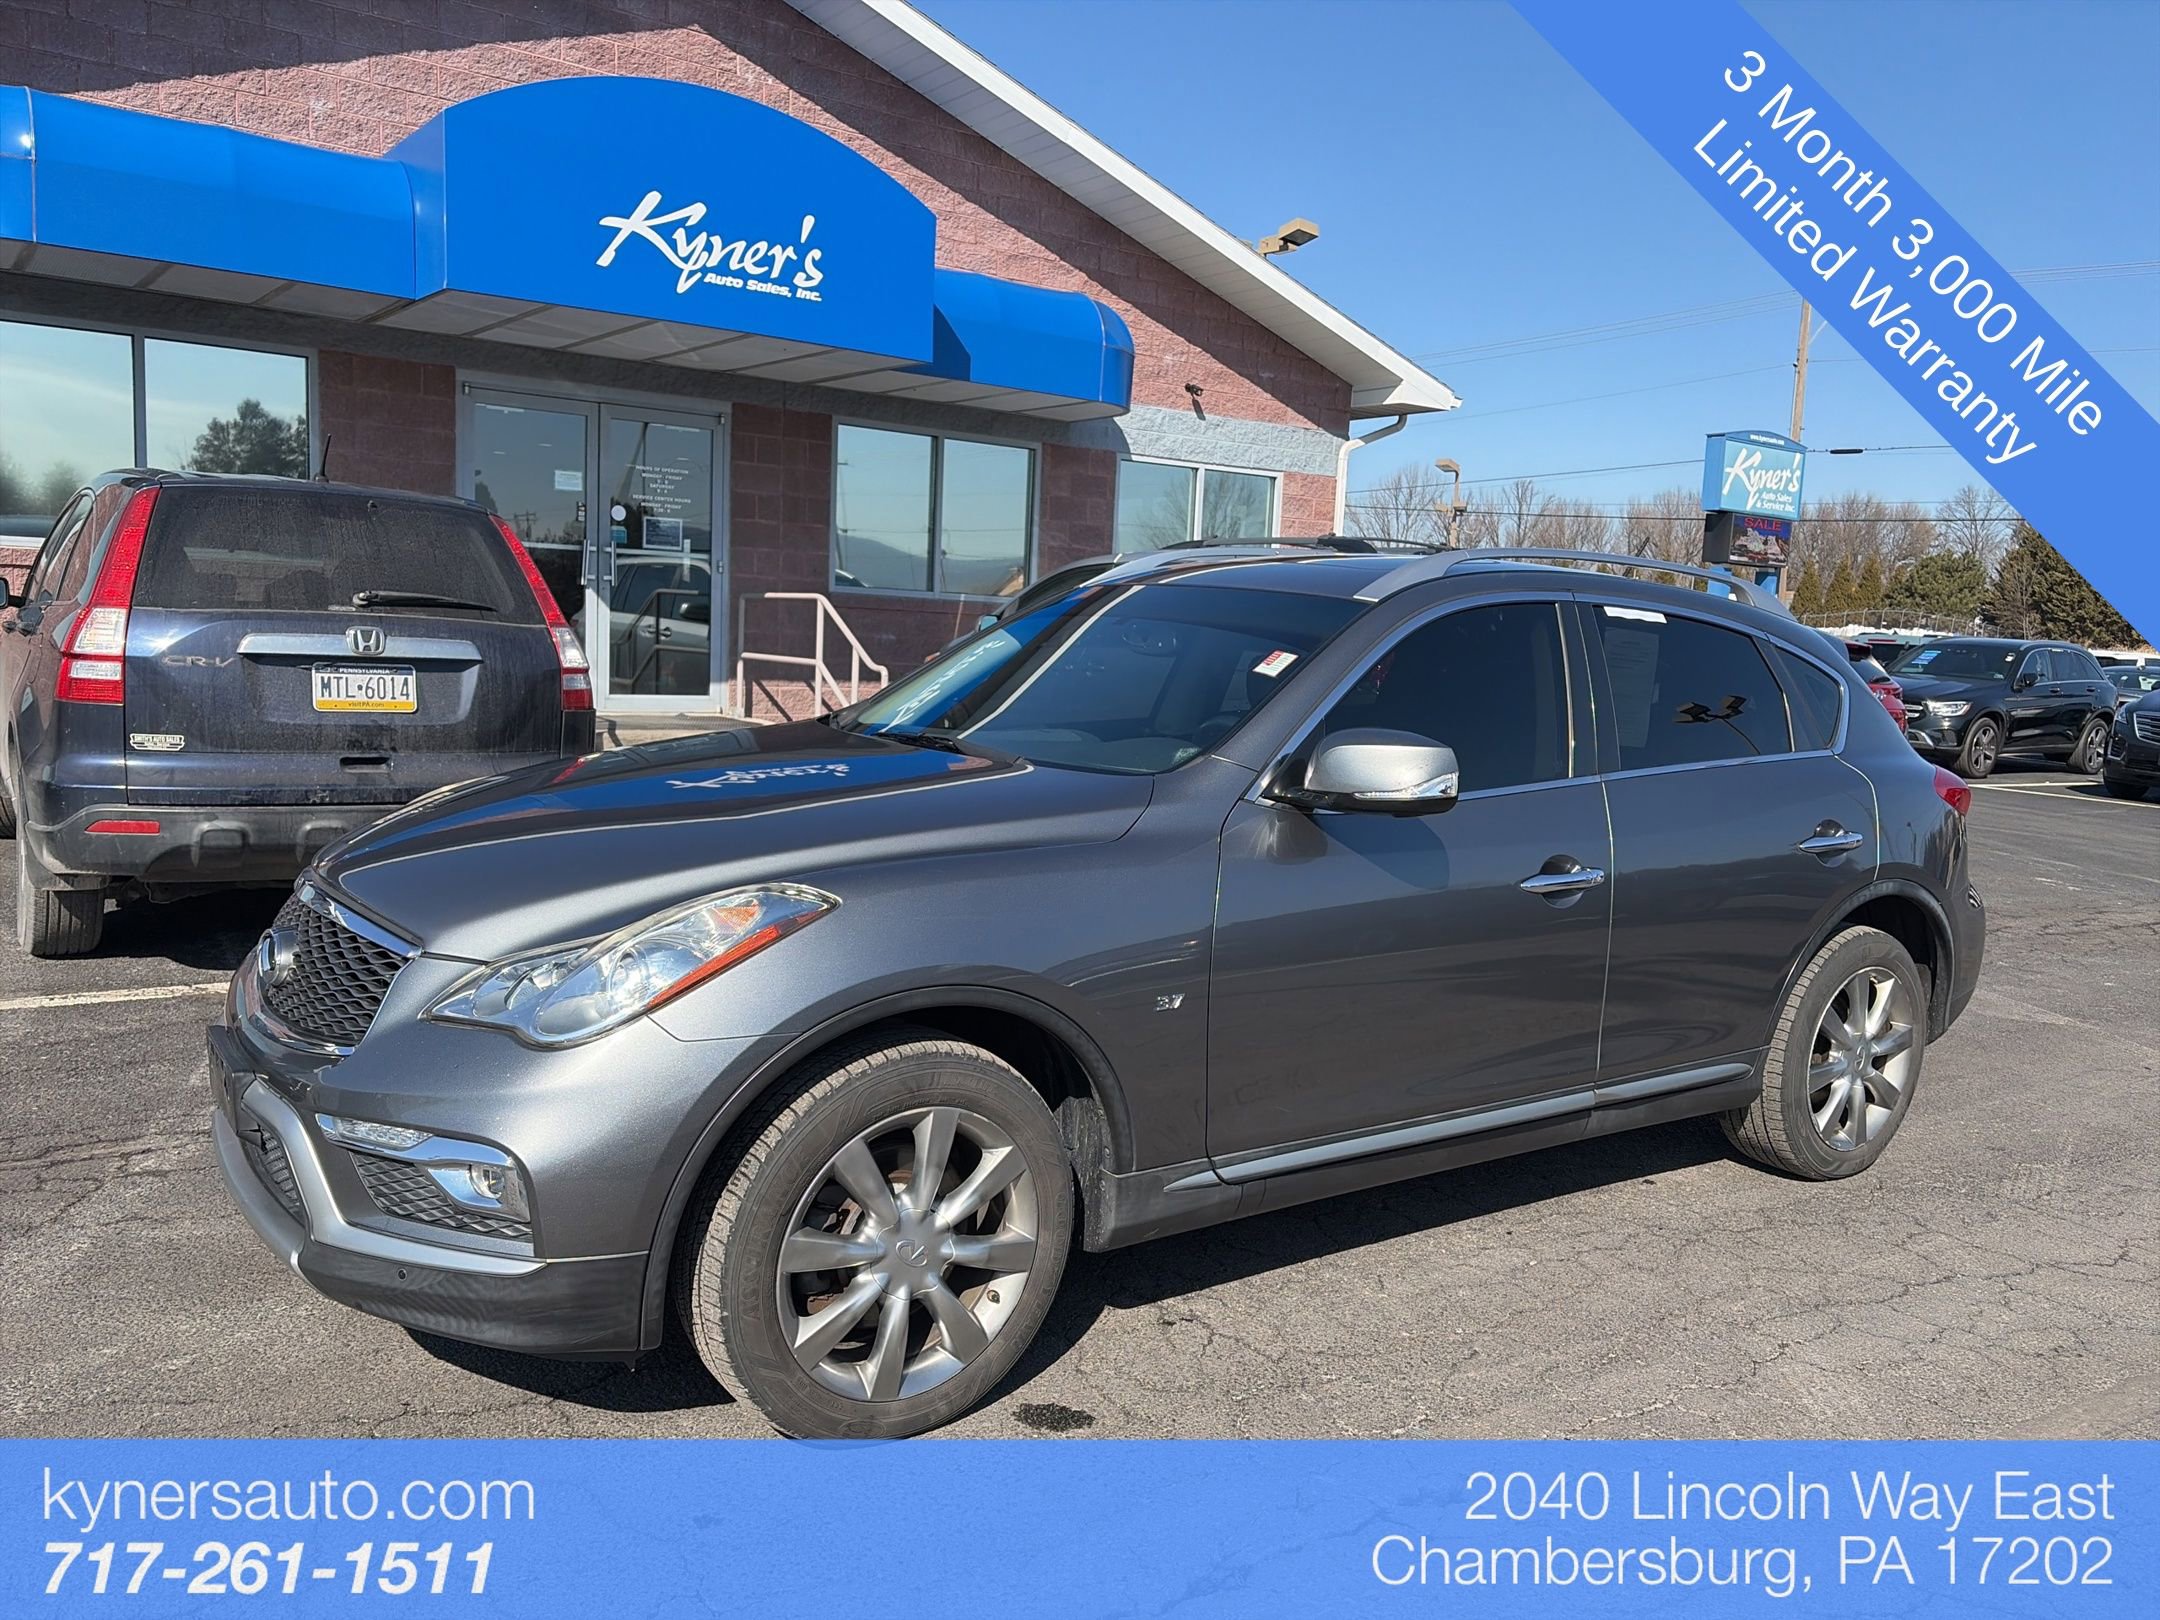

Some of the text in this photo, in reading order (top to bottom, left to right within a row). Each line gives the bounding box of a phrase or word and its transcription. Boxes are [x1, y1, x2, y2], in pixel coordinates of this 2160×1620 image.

[596, 190, 824, 294] Kyner's
[704, 272, 822, 301] Auto Sales, Inc.
[1722, 447, 1801, 511] Kyner's
[1761, 491, 1792, 502] Auto Sales
[1762, 500, 1784, 511] Service
[1744, 517, 1782, 531] SALE
